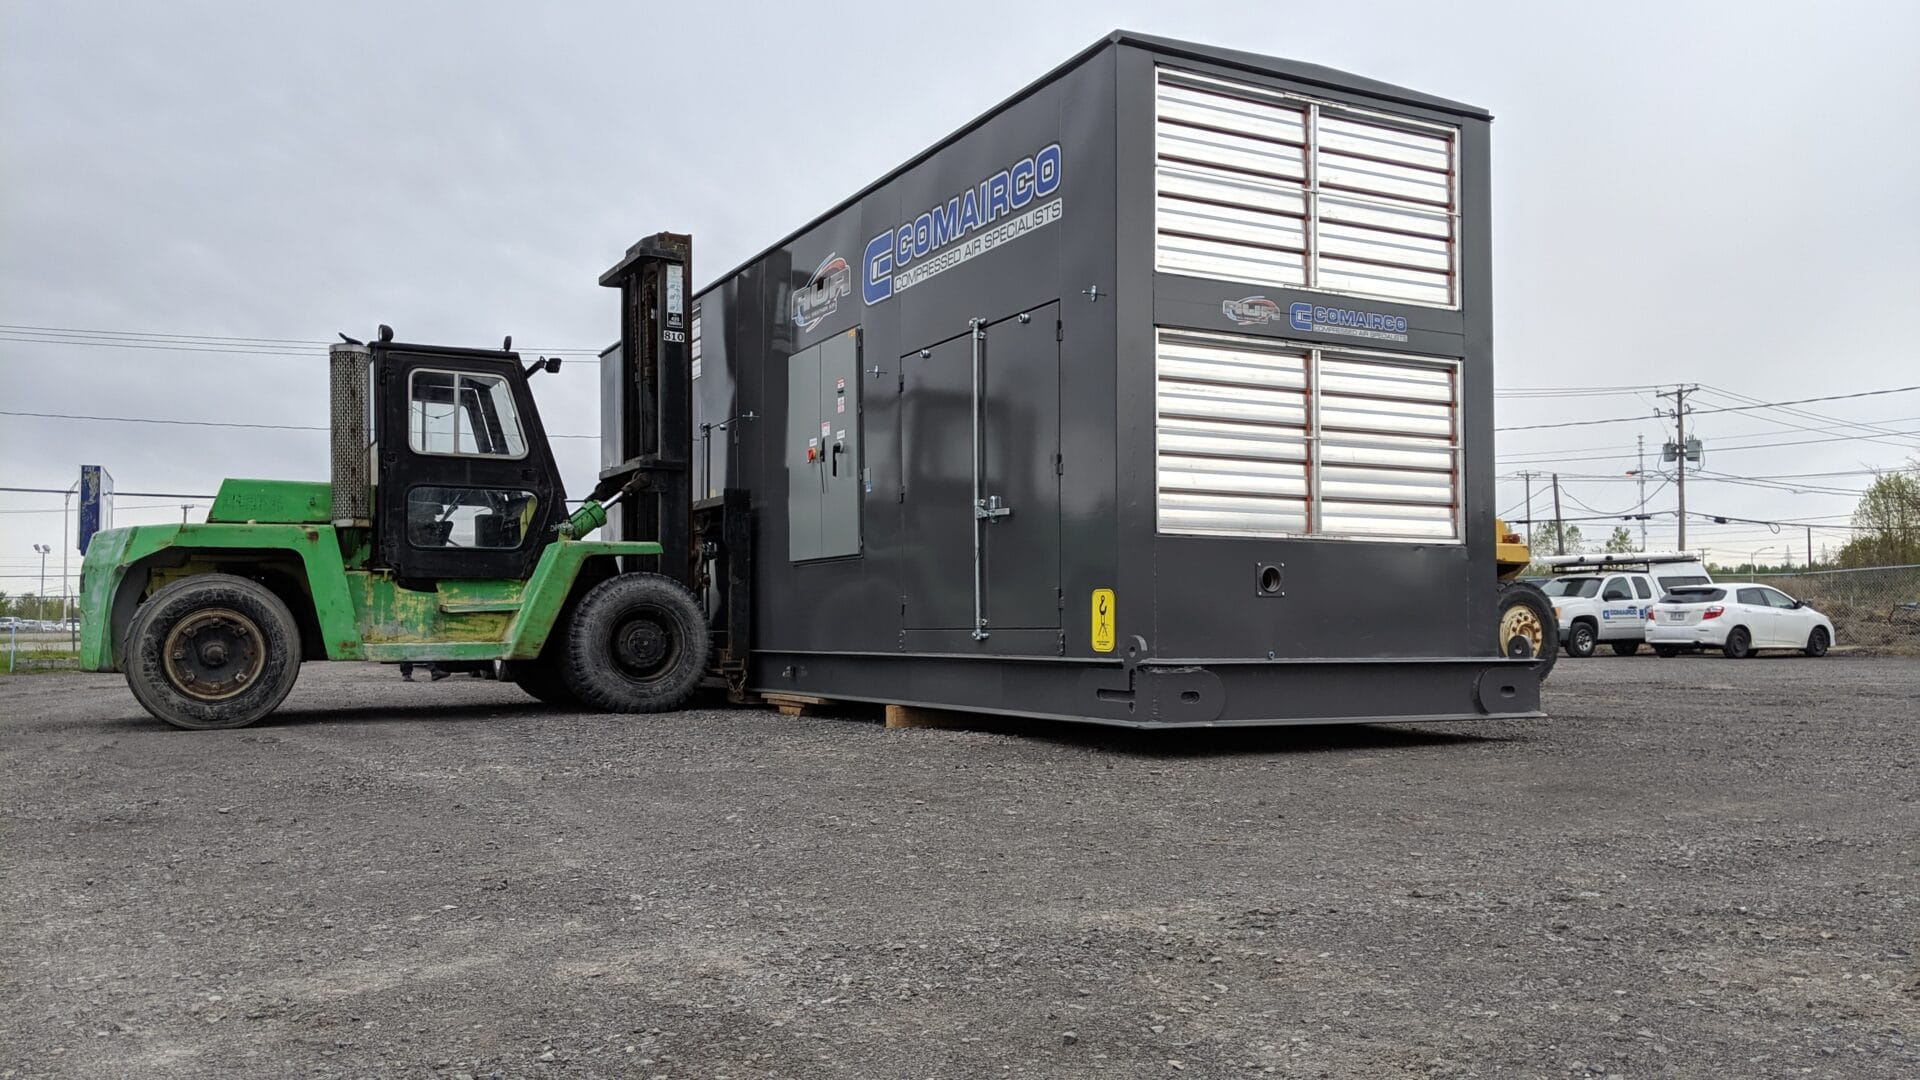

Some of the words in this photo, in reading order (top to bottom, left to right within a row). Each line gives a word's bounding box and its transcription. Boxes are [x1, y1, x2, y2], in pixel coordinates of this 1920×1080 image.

[895, 143, 1062, 268] COMAIRCO
[895, 249, 961, 291] COMPRESSED
[964, 239, 981, 258] AIR
[984, 202, 1061, 249] SPECIALISTS
[664, 331, 684, 341] 810
[1313, 306, 1408, 333] COMAIRCO
